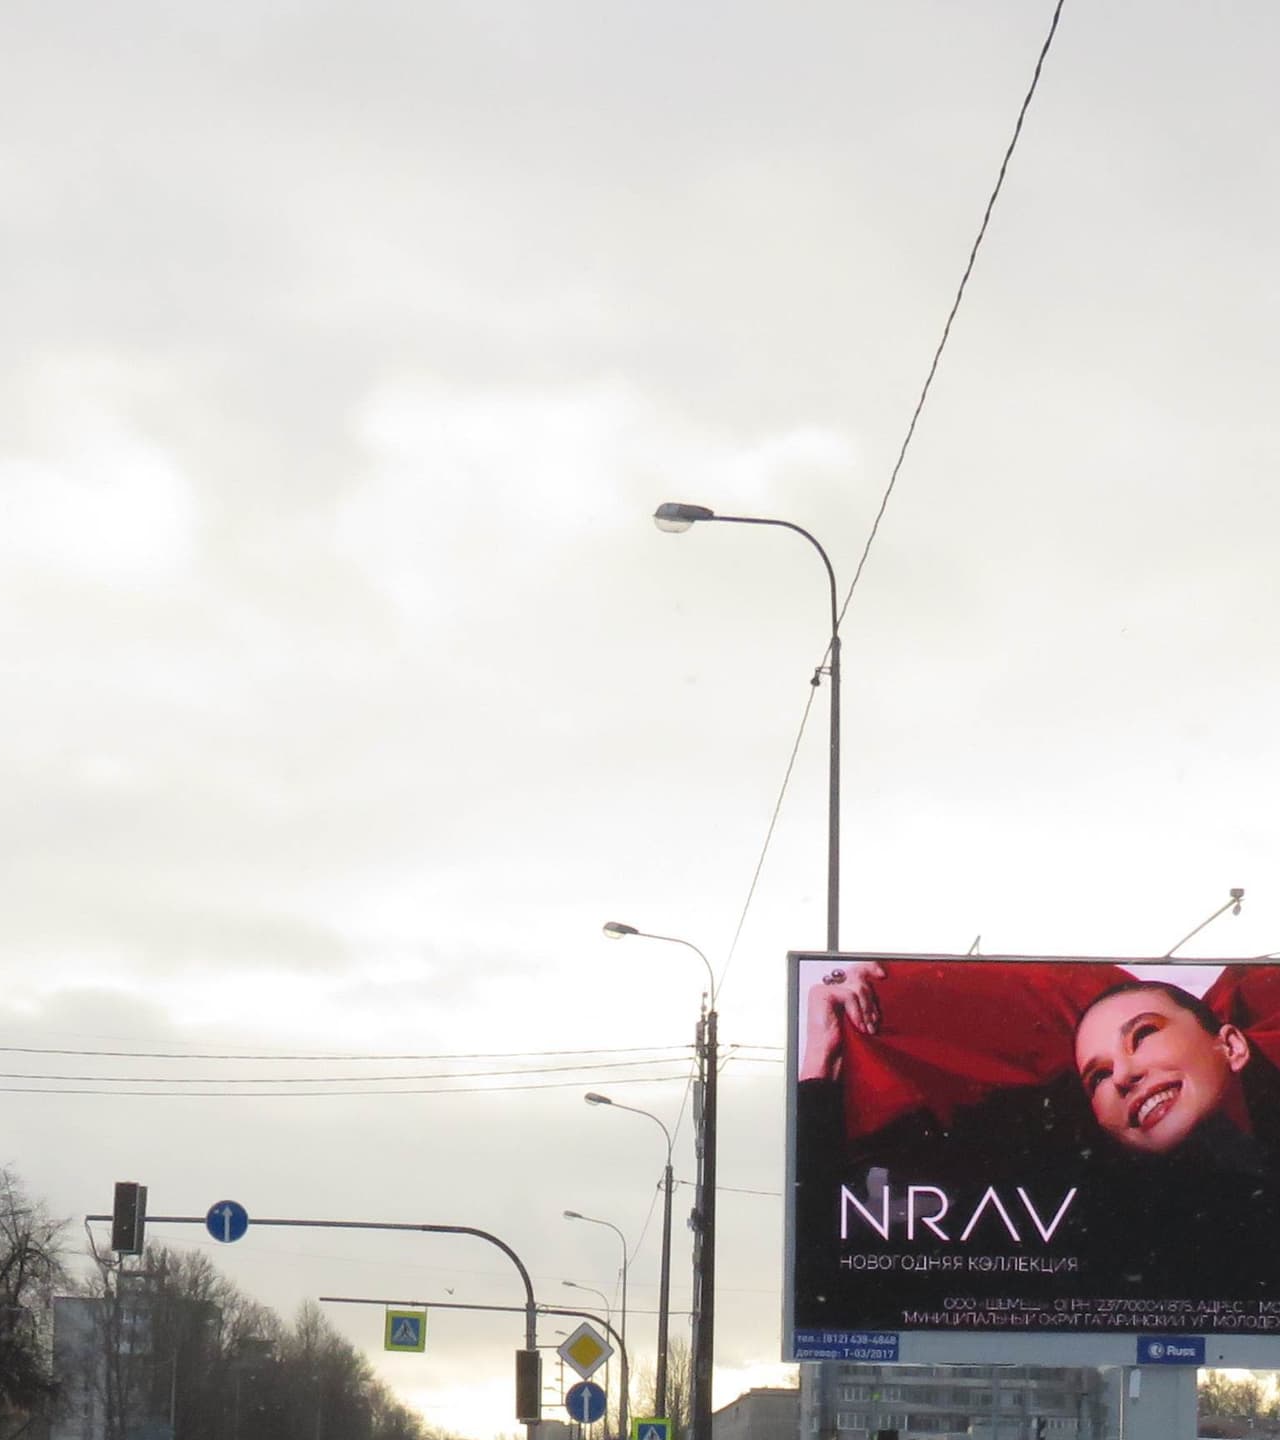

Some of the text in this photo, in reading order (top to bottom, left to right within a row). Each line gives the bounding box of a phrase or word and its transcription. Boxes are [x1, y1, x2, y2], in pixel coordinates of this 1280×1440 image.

[840, 1184, 1078, 1243] NRAV
[839, 1254, 1079, 1274] НОВОГОДНЯЯ КОЛЛЕКЦИЯ
